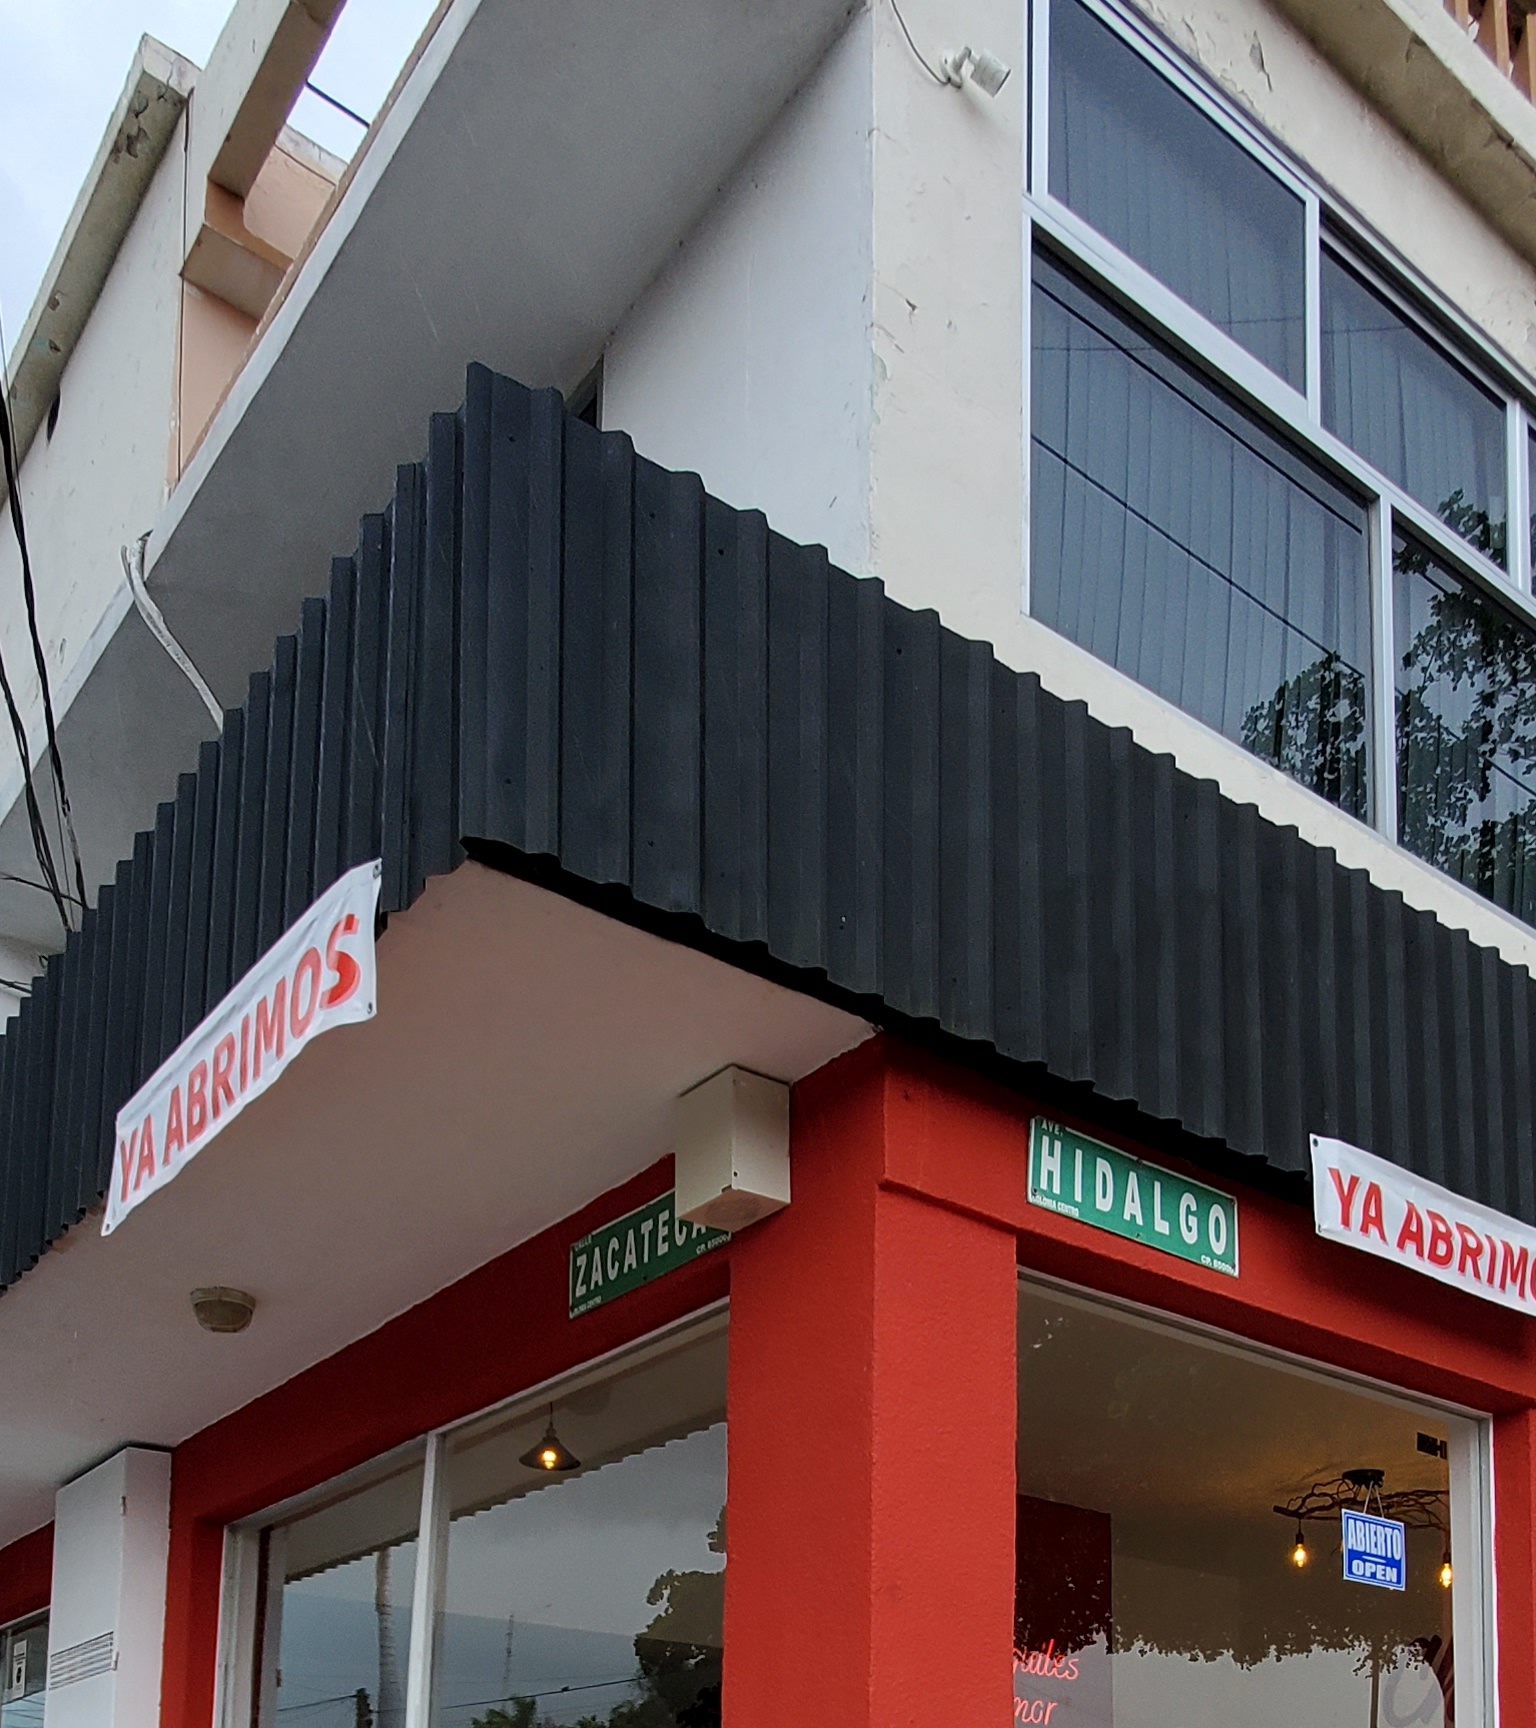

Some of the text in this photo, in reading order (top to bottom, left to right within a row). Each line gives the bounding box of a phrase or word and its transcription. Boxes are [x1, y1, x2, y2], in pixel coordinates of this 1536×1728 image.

[120, 913, 362, 1203] YA ABRIMOS
[1039, 1134, 1228, 1256] HIDALGO
[1327, 1166, 1388, 1246] YA
[575, 1208, 707, 1299] ZACATEC
[1347, 1518, 1402, 1561] ABIERTO
[1351, 1559, 1398, 1584] OPEN
